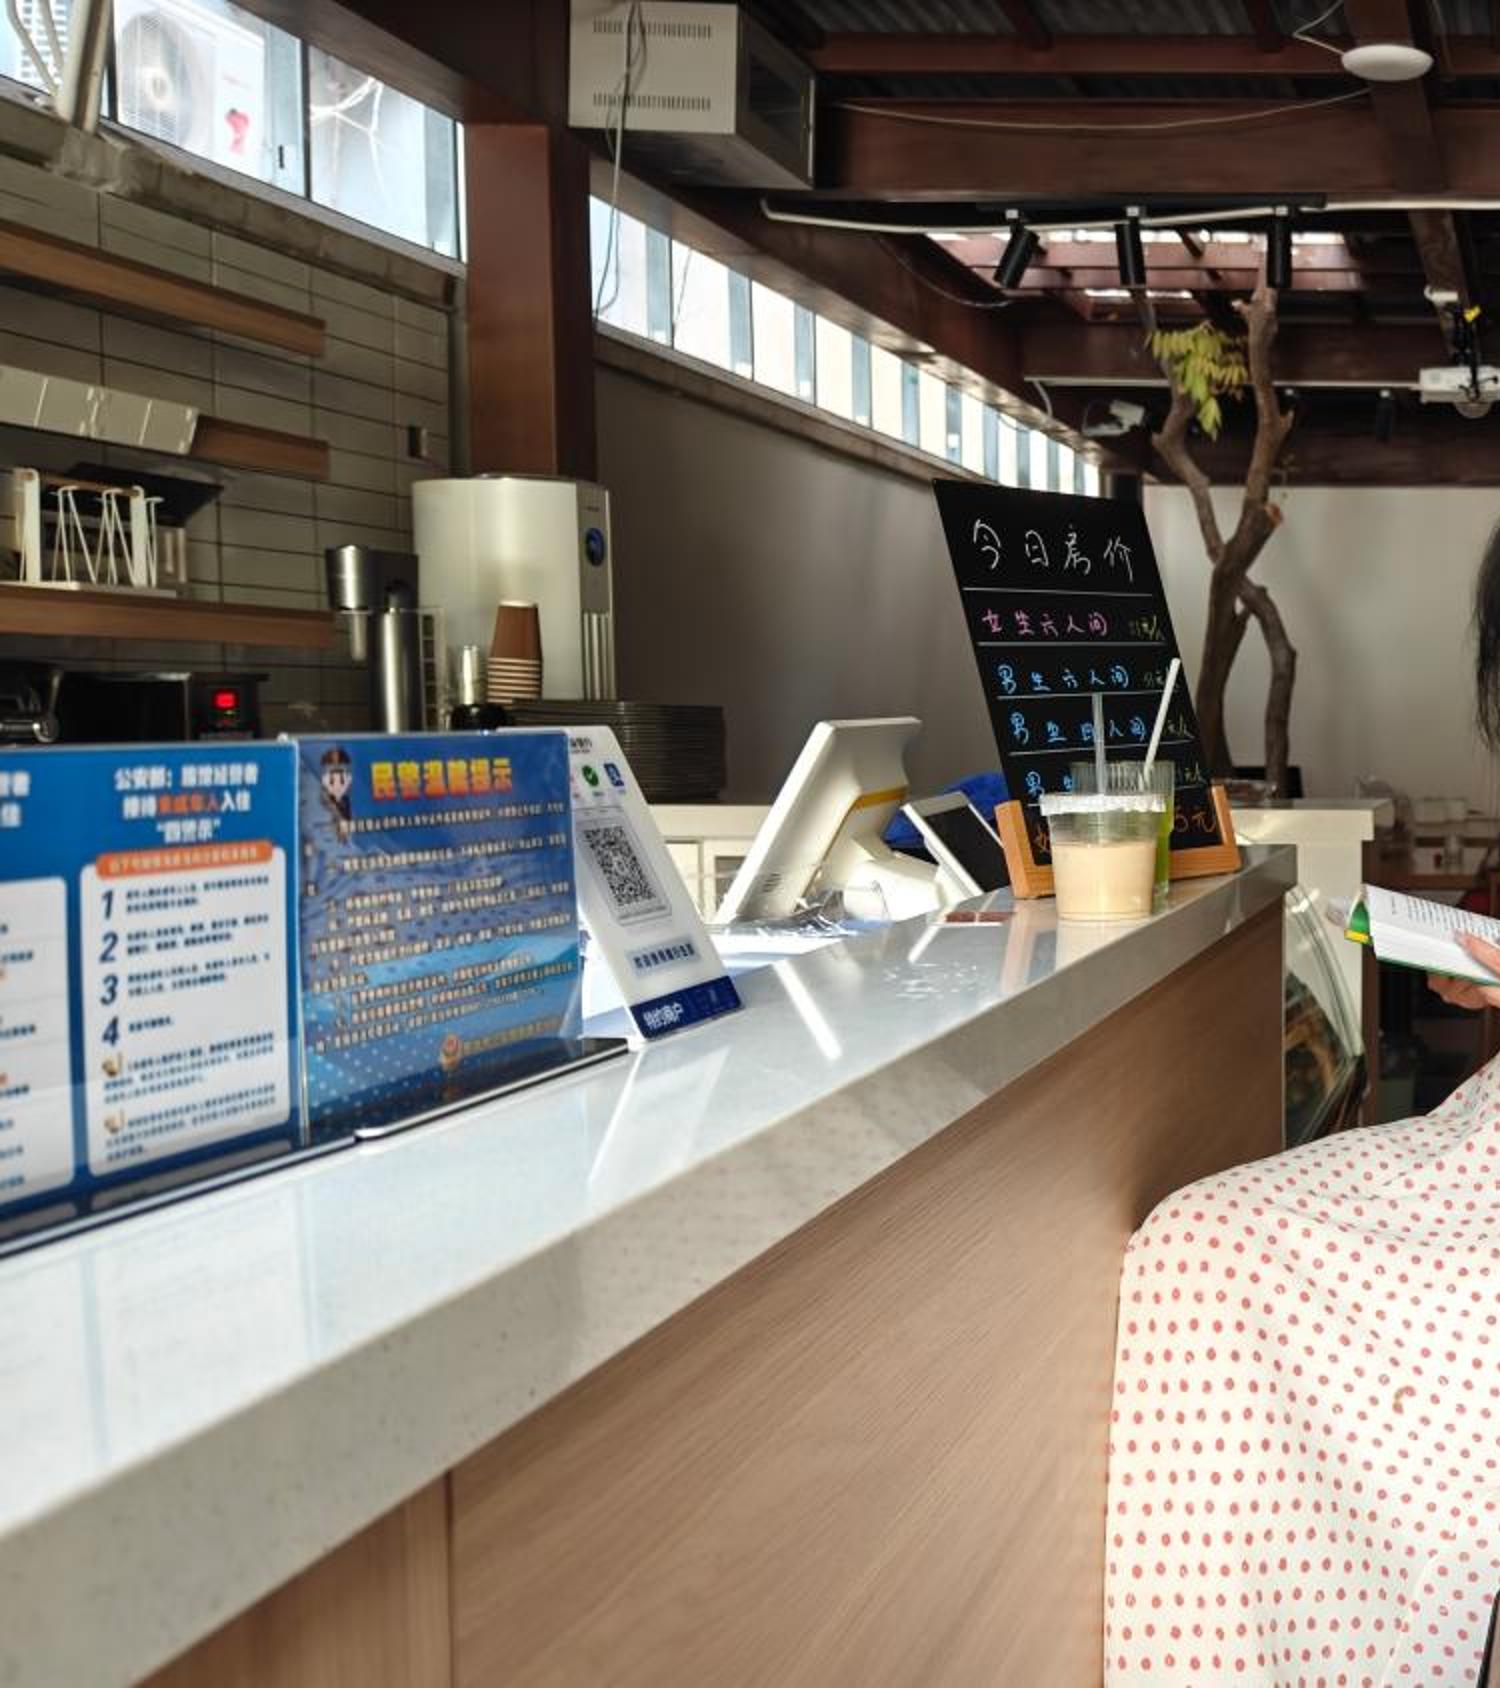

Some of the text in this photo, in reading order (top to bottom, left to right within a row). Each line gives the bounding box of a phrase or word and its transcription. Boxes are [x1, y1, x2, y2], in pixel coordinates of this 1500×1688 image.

[973, 519, 1133, 583] 今日房价
[982, 609, 1107, 637] 女生六人间
[998, 664, 1129, 694] 男生六人间
[102, 889, 114, 920] 1
[99, 931, 119, 964] 2
[100, 974, 119, 1006] 3
[102, 1015, 120, 1046] 4
